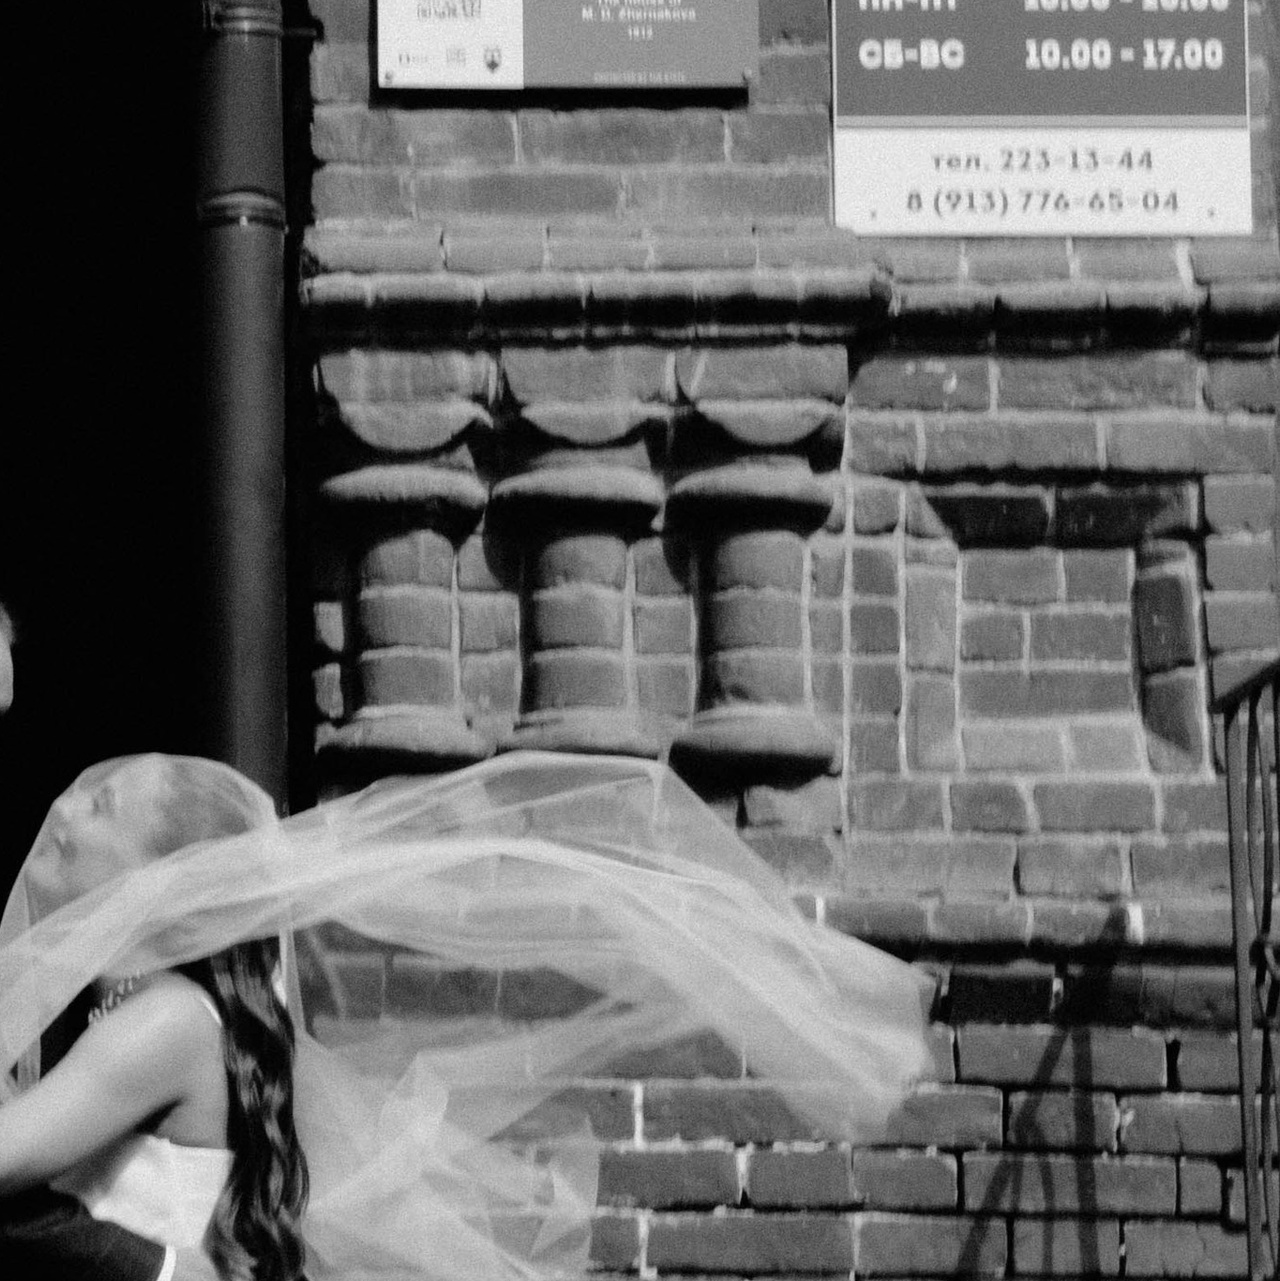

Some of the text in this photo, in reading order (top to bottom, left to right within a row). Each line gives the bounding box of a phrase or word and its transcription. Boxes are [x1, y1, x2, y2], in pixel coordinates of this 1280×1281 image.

[858, 39, 965, 71] СБ-ВС
[1025, 39, 1112, 71] 10.00
[1143, 39, 1224, 71] 17.00
[1002, 150, 1153, 172] 223-13-44
